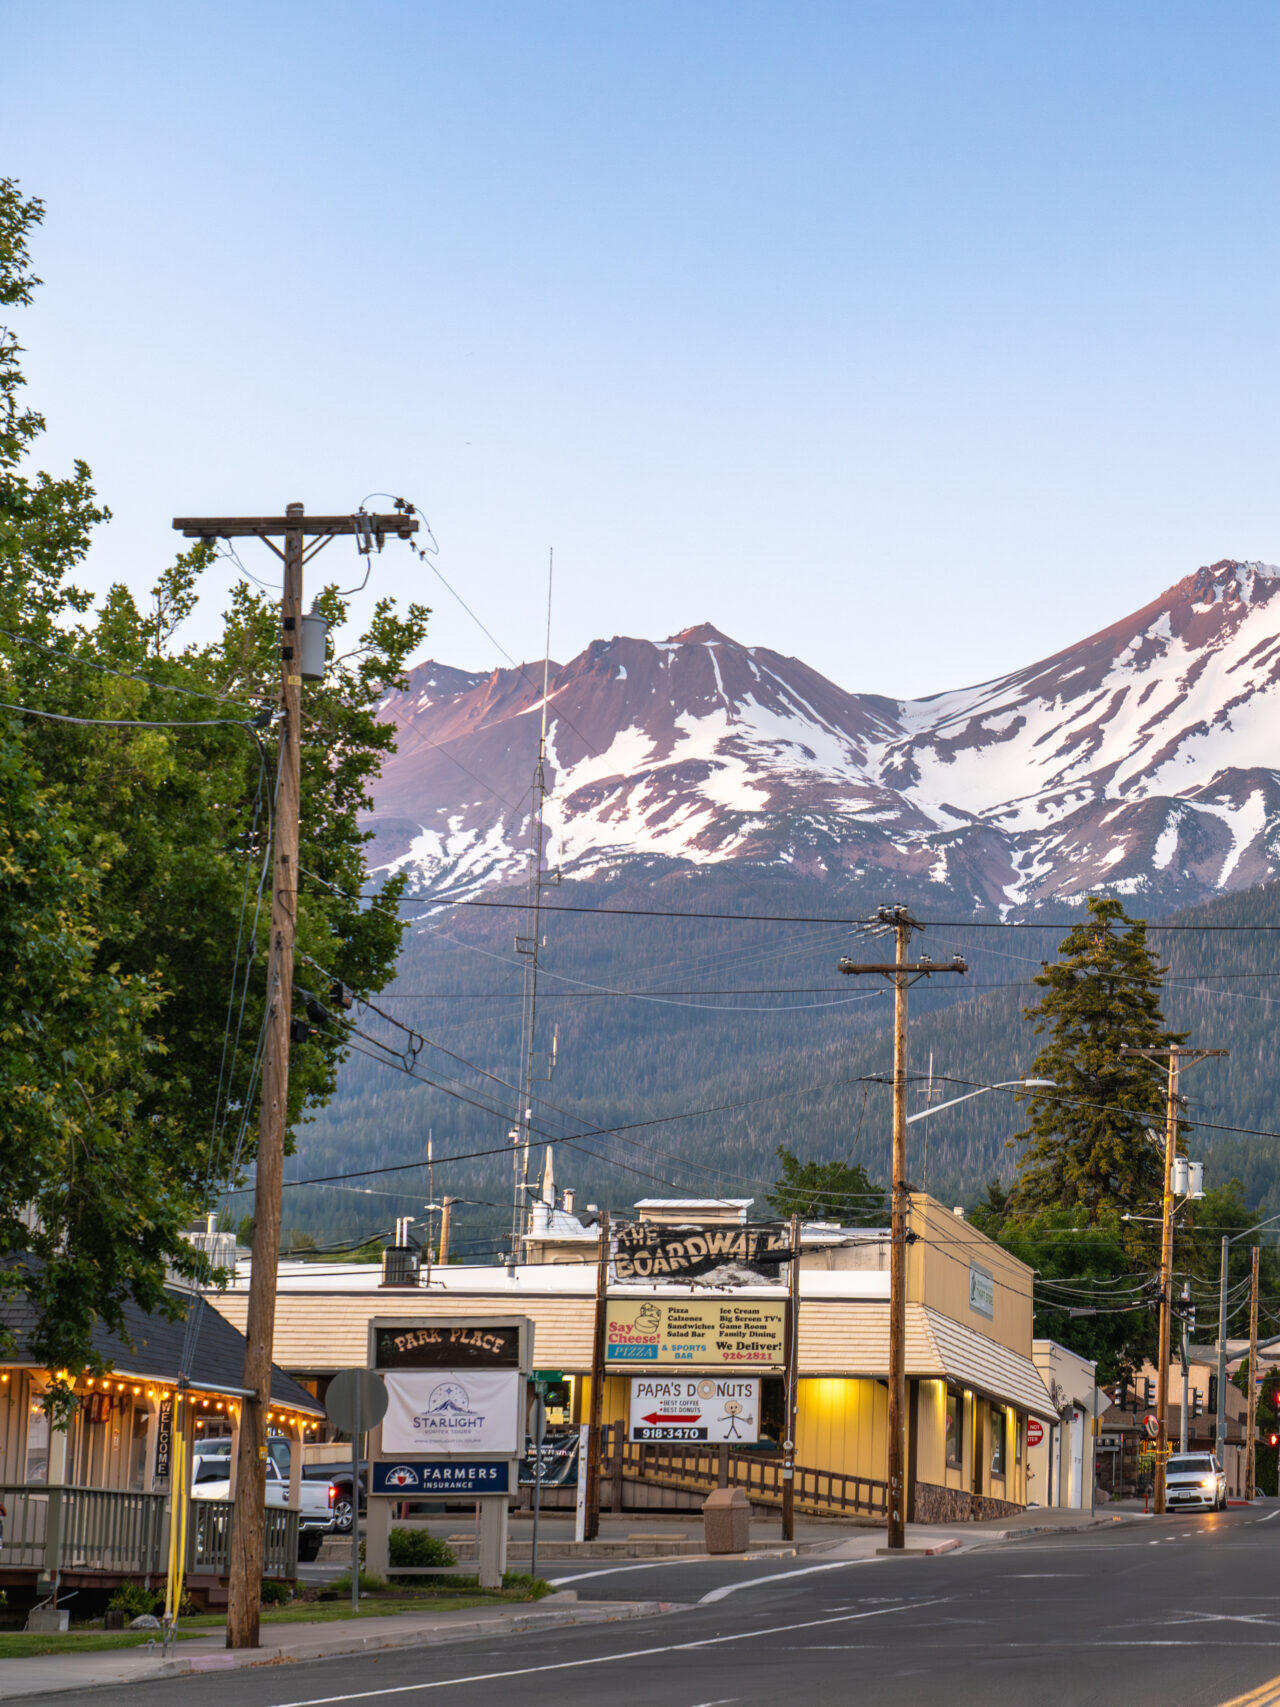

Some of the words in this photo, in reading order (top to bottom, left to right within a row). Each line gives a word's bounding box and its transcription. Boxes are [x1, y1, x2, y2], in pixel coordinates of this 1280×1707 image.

[616, 1227, 661, 1247] THE
[614, 1231, 784, 1278] BOARDWALK
[608, 1321, 634, 1334] Say
[394, 1328, 442, 1352] PARK
[450, 1328, 504, 1353] PLACE
[608, 1333, 661, 1344] Cheese!
[614, 1346, 653, 1357] PIZZA
[716, 1342, 733, 1350] We
[736, 1342, 782, 1350] Deliver!
[722, 1352, 772, 1360] 926-2821
[637, 1381, 682, 1398] PAPA'S
[687, 1380, 752, 1400] DONUTS
[413, 1417, 485, 1428] STARLIGHT
[158, 1402, 172, 1474] WELCOME
[423, 1468, 498, 1480] FARMERS
